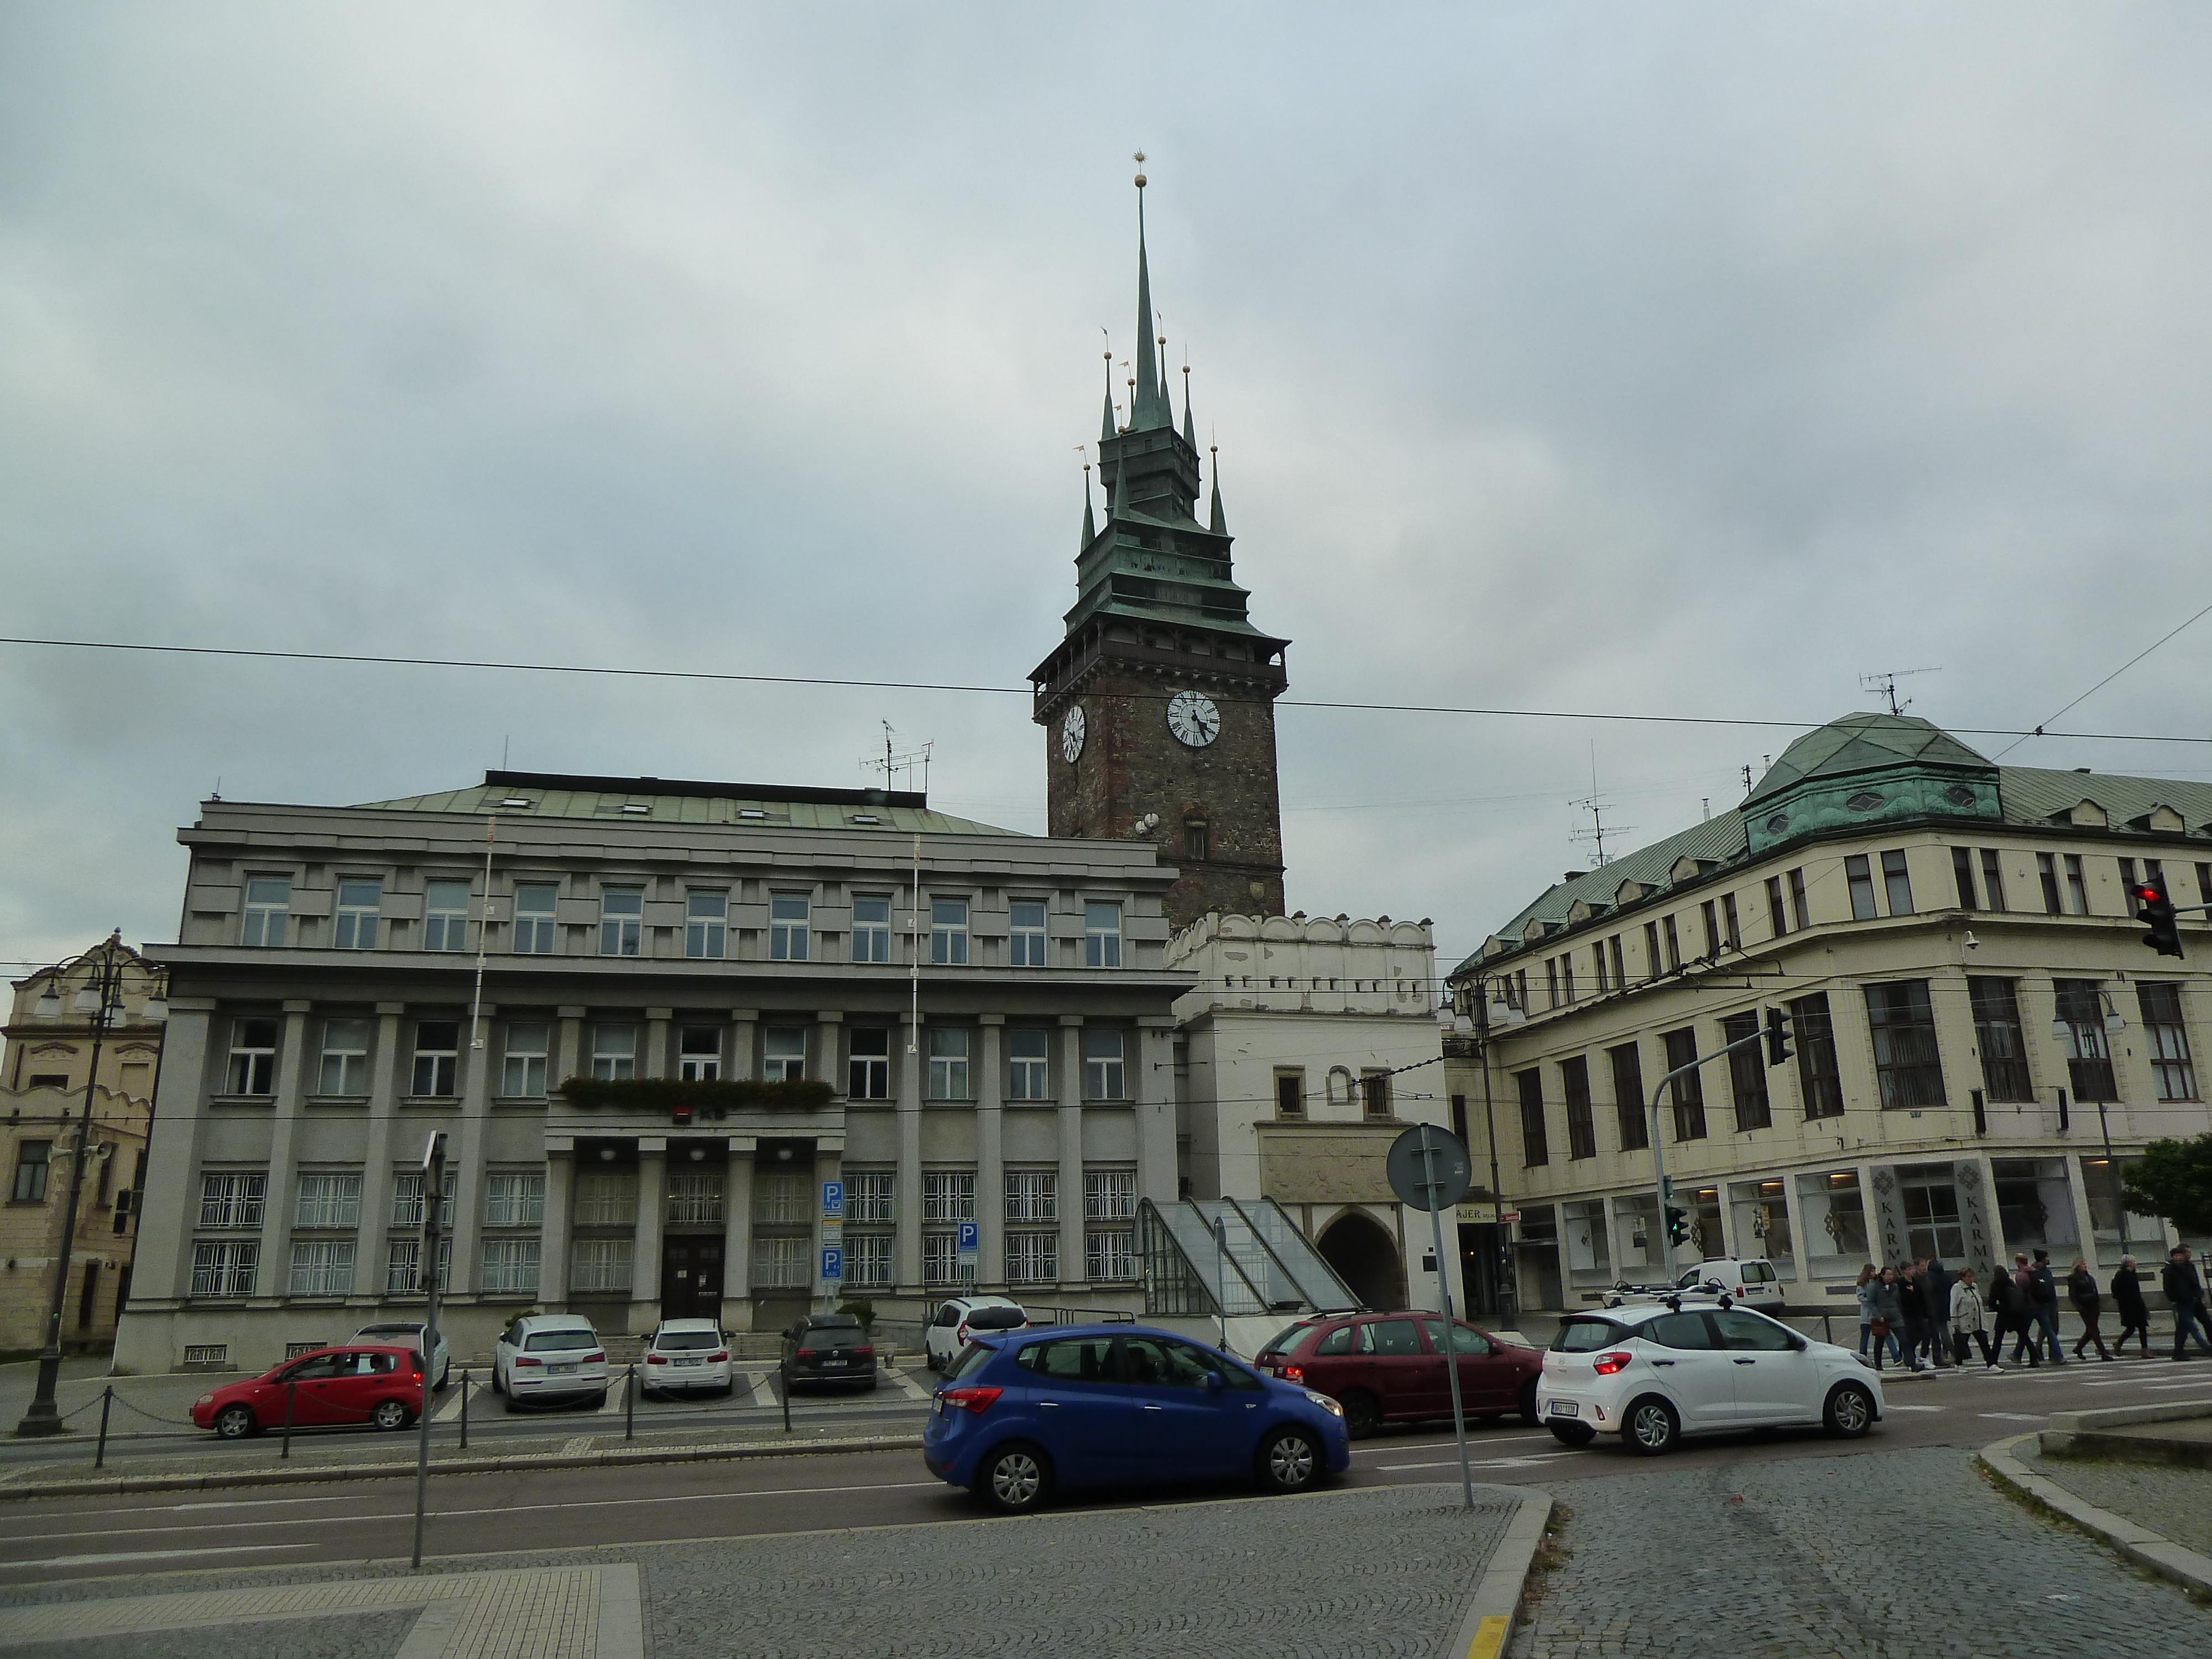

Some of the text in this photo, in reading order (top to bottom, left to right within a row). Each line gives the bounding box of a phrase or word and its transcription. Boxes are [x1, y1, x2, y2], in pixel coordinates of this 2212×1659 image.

[827, 1186, 838, 1202] P
[963, 1225, 974, 1242] P
[1882, 1202, 1902, 1276] KARMA
[1966, 1196, 1989, 1273] KARMA
[825, 1253, 837, 1270] P
